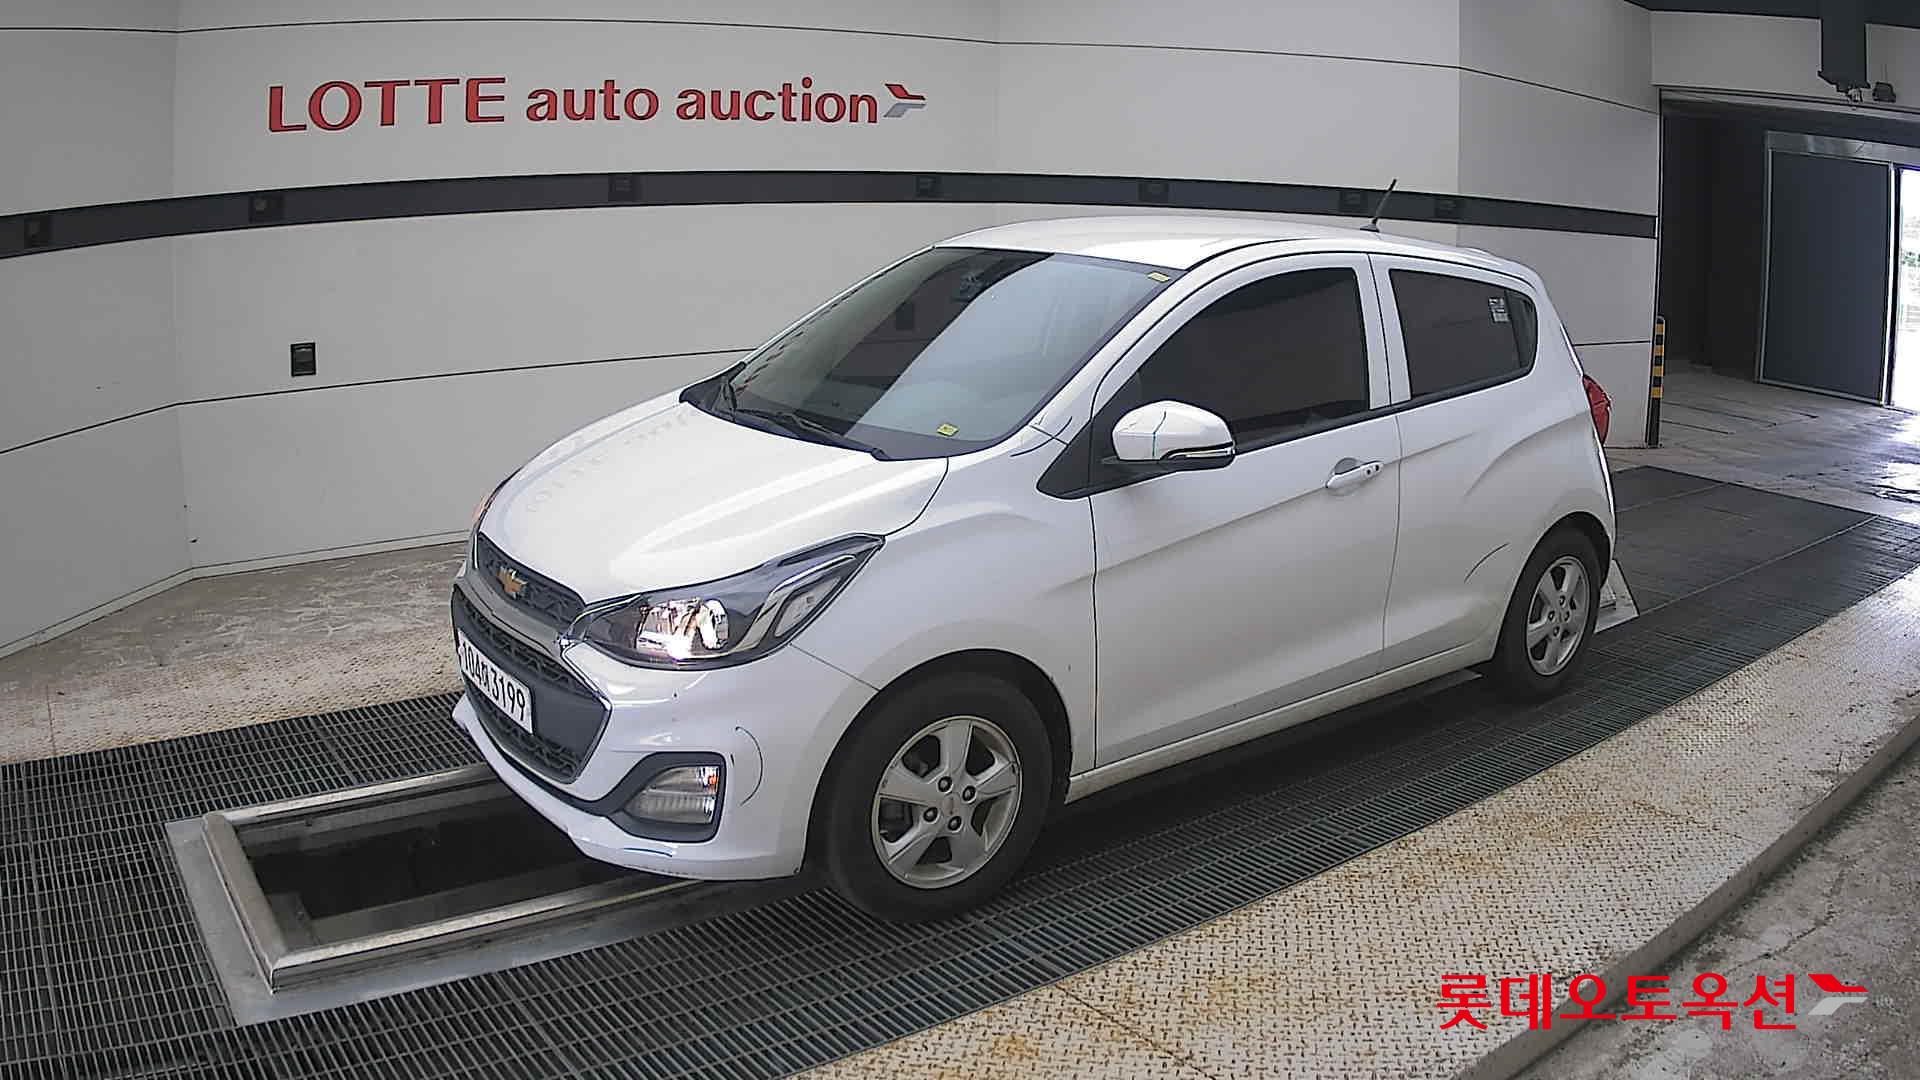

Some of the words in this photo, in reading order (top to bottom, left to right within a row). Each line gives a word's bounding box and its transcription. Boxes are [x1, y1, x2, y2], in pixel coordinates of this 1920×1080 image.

[269, 77, 505, 132] LOTTE
[526, 79, 659, 122] auto
[675, 77, 878, 123] auction
